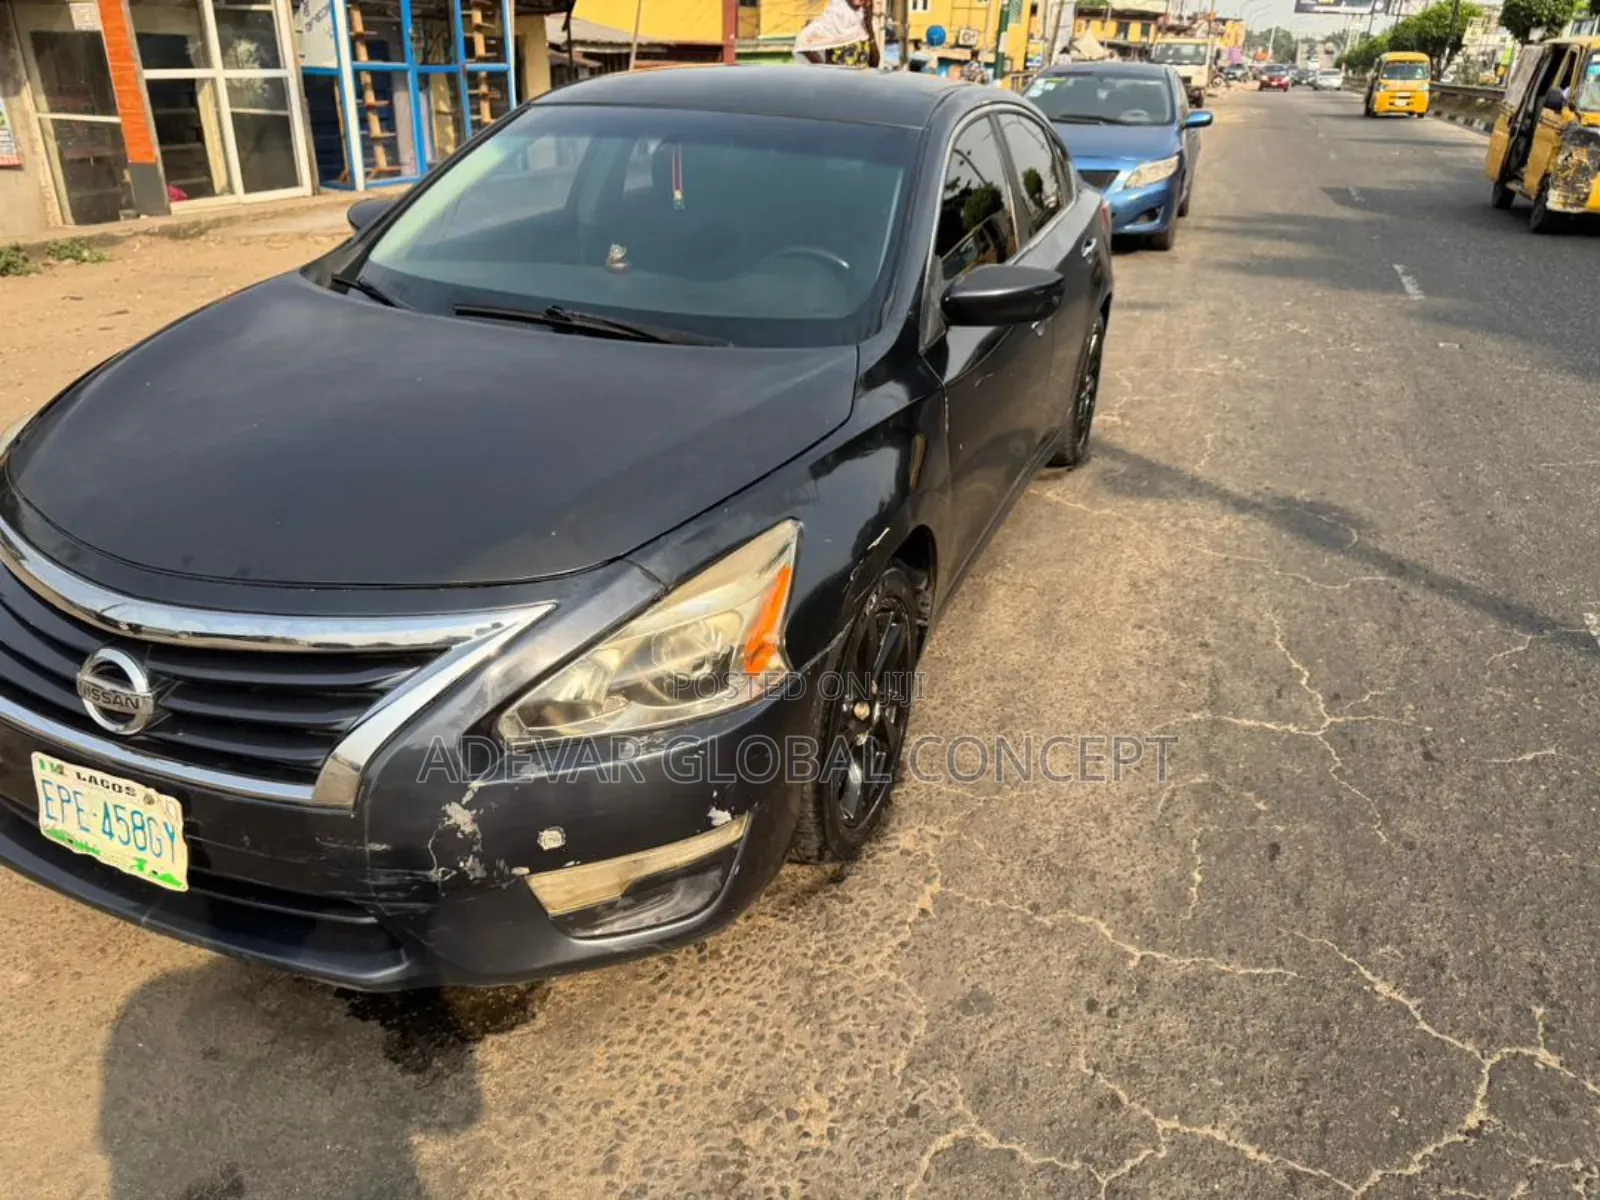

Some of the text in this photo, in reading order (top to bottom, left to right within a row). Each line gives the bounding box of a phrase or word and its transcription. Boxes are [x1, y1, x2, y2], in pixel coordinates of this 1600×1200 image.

[80, 682, 140, 710] NISSAN
[75, 771, 137, 797] LAGOS
[41, 779, 176, 864] EPE-458GY
